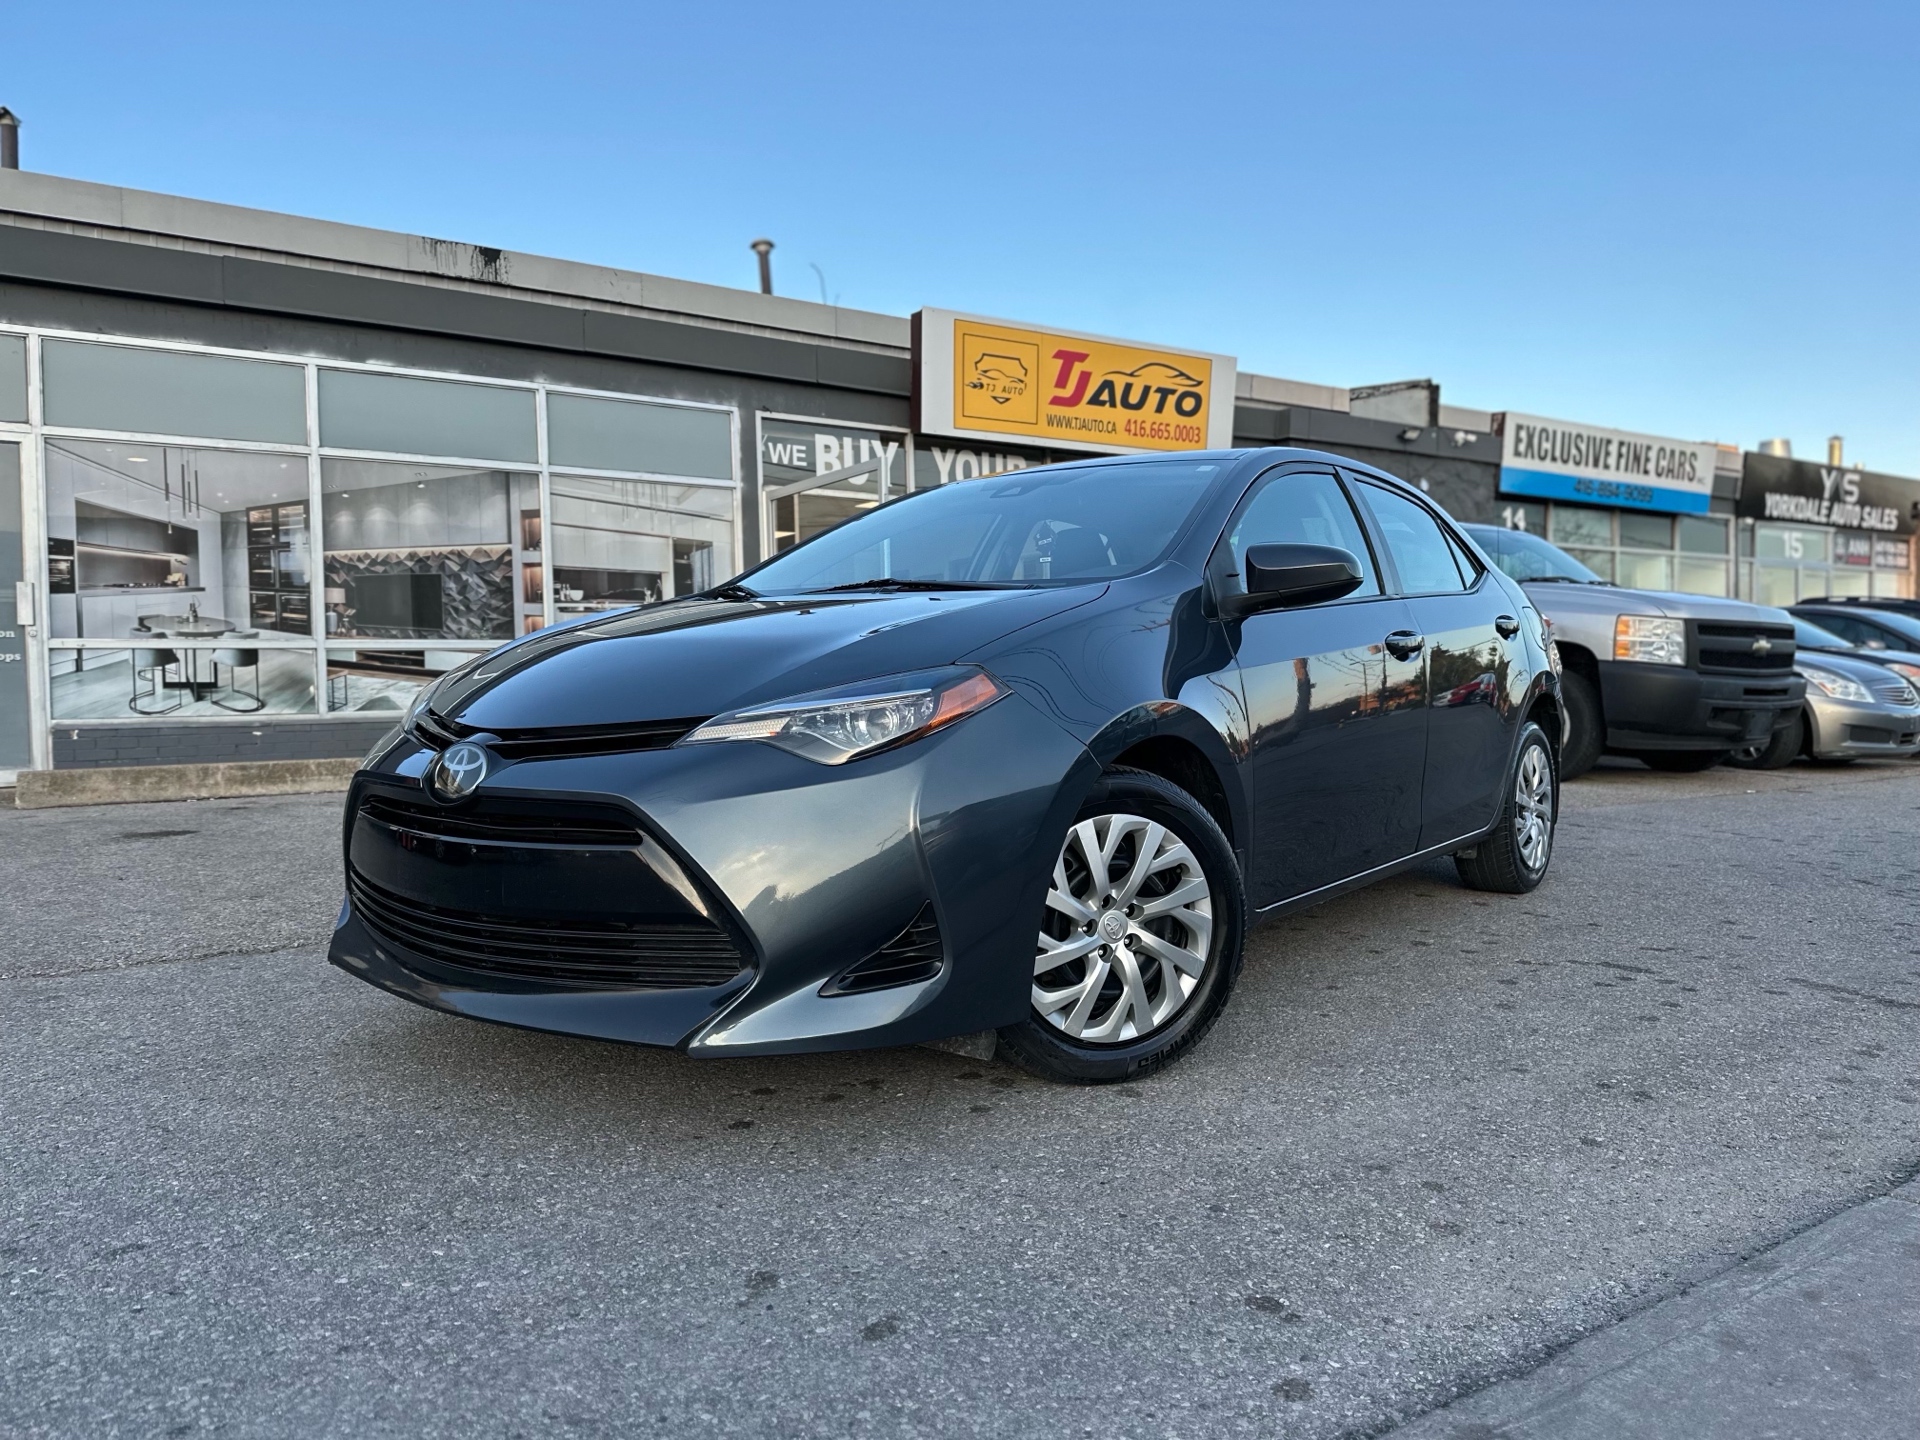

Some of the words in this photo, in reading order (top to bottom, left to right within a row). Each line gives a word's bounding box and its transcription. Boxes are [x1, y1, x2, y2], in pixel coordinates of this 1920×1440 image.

[986, 383, 996, 392] TJ
[1001, 385, 1024, 396] AUTO
[1048, 349, 1092, 408] TJ
[1086, 380, 1203, 417] AUTO
[1046, 413, 1117, 434] WWW.TJAUTO.CA
[1124, 418, 1201, 444] 416.665.0003
[768, 441, 807, 466] WE
[815, 433, 899, 488] BUY
[1513, 423, 1613, 471] EXCLUSIVE
[1615, 439, 1653, 476] FINE
[1655, 446, 1698, 483] CARS
[1502, 506, 1526, 531] 14
[1764, 491, 1830, 523] YORKDALE
[1829, 501, 1861, 528] AUTO
[1861, 505, 1899, 531] SALES
[1783, 530, 1804, 558] 15
